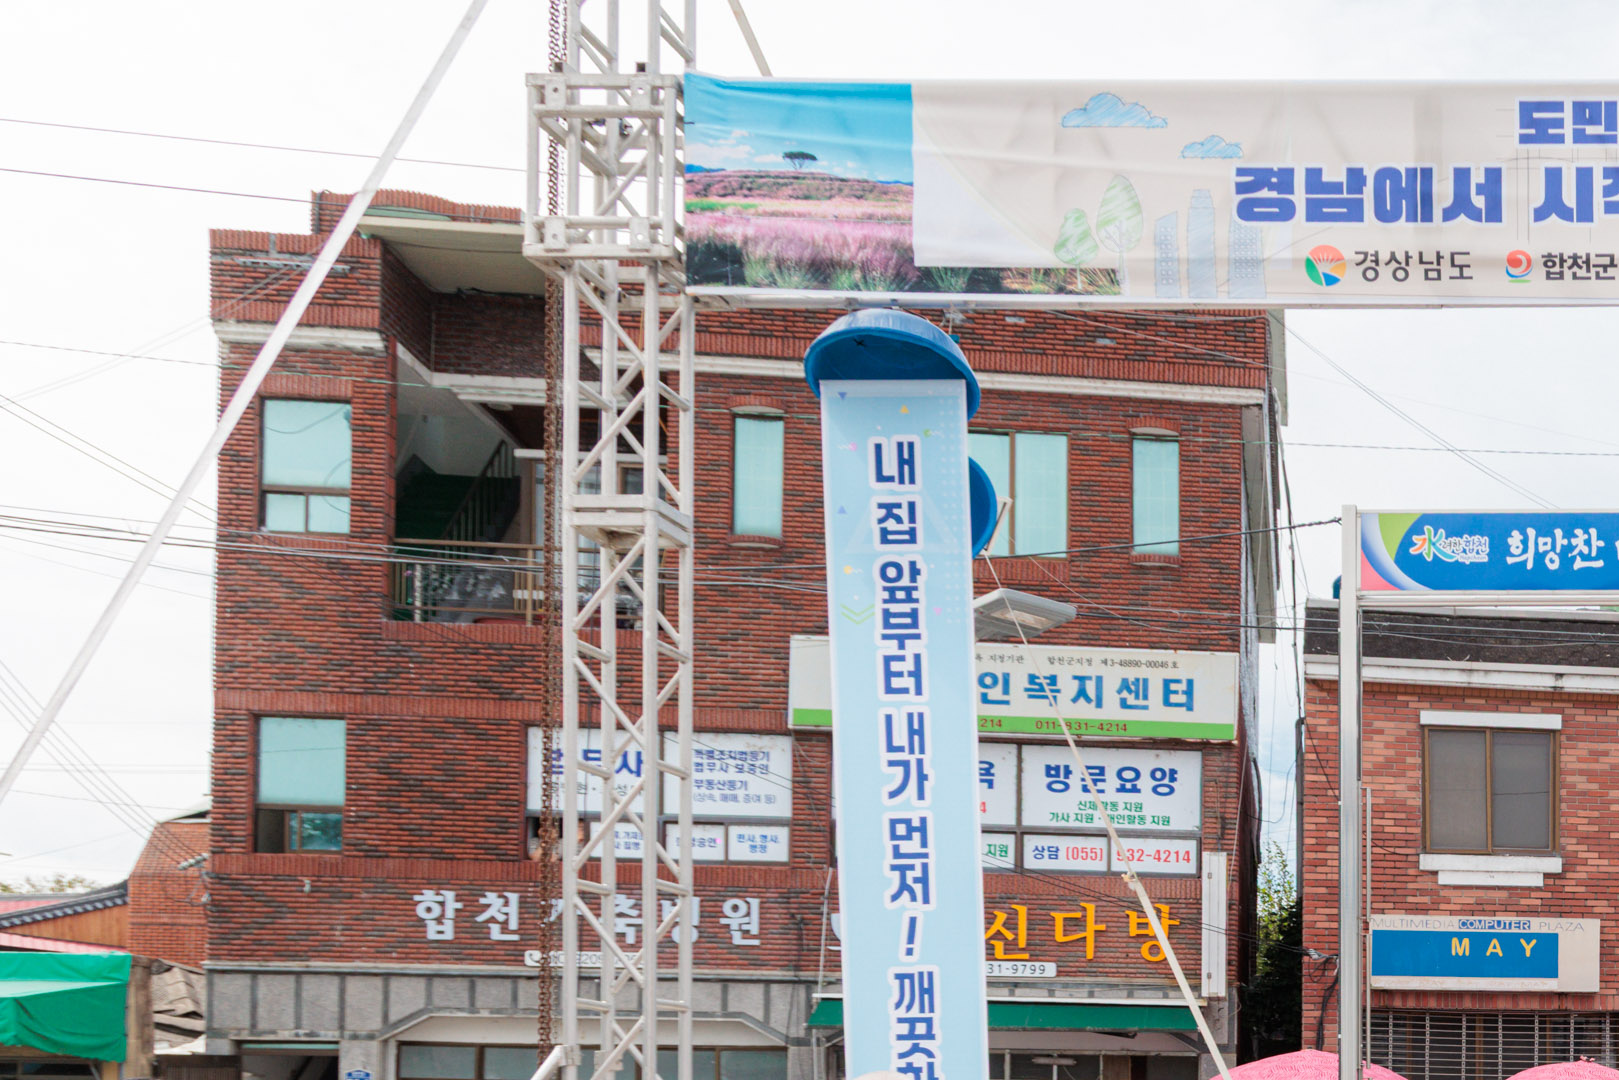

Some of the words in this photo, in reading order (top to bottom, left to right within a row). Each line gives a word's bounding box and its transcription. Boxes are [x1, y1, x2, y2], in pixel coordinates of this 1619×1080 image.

[1234, 165, 1504, 224] 경남에서
[1354, 250, 1474, 282] 경상남도
[1541, 252, 1617, 281] 합천군
[874, 441, 917, 485] 내
[876, 501, 919, 545] 집
[1506, 527, 1605, 571] 희망찬
[879, 560, 923, 697] 앞부터
[977, 671, 1195, 712] 인복지센터
[884, 711, 929, 802] 내가
[1044, 763, 1179, 797] 방문요양
[1049, 812, 1070, 823] 가사
[1073, 812, 1095, 824] 지원
[1150, 815, 1171, 827] 지원
[1122, 801, 1144, 813] 지원
[986, 843, 1009, 858] 지원
[1032, 845, 1060, 860] 상담
[1065, 846, 1104, 861] (055)
[1371, 918, 1455, 930] MULTIMEDIA
[1458, 919, 1530, 930] COMPUTER
[1539, 921, 1585, 932] PLAZA
